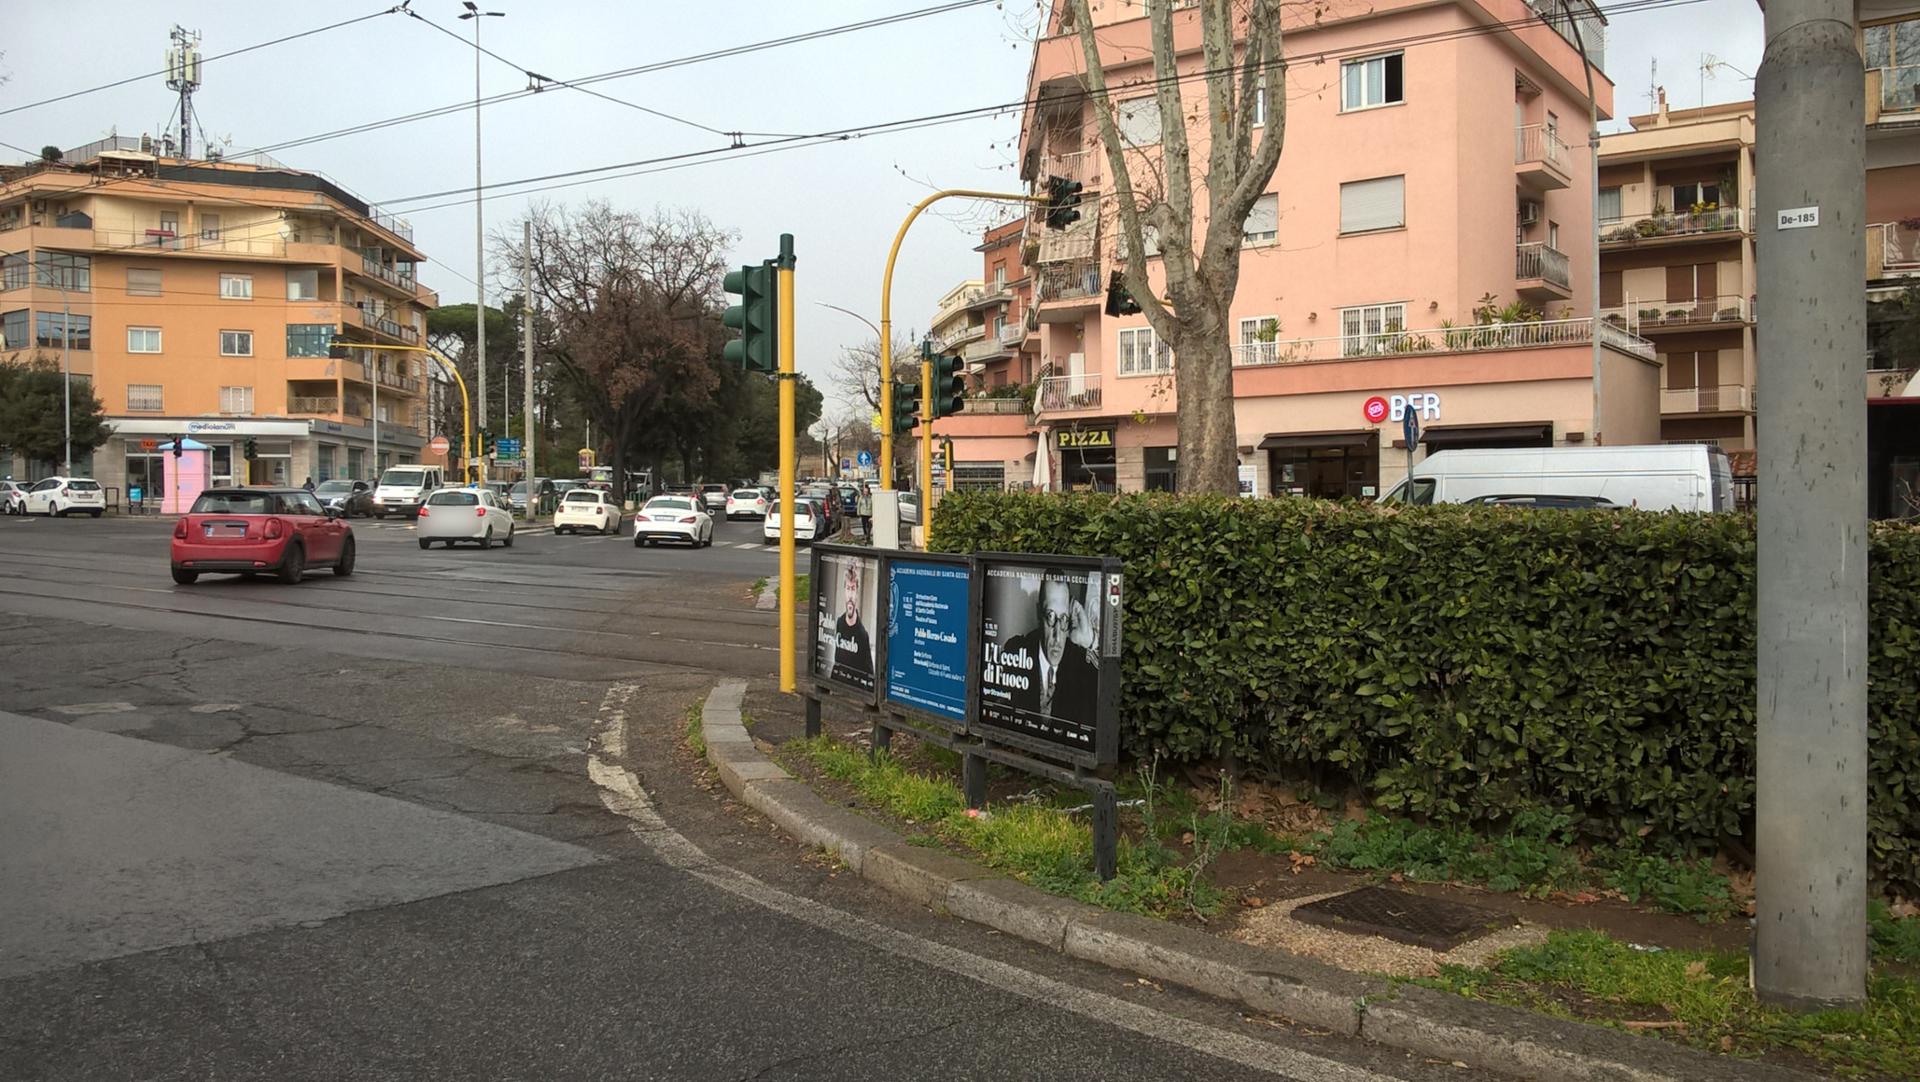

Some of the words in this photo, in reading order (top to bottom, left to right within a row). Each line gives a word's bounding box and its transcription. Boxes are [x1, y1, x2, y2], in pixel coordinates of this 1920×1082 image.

[1781, 213, 1815, 225] De-185
[1058, 430, 1112, 447] PIZZA
[987, 569, 1015, 578] ACCADEMIA
[1053, 575, 1070, 583] SANTA
[983, 662, 994, 684] di
[995, 665, 1029, 690] Fuoco
